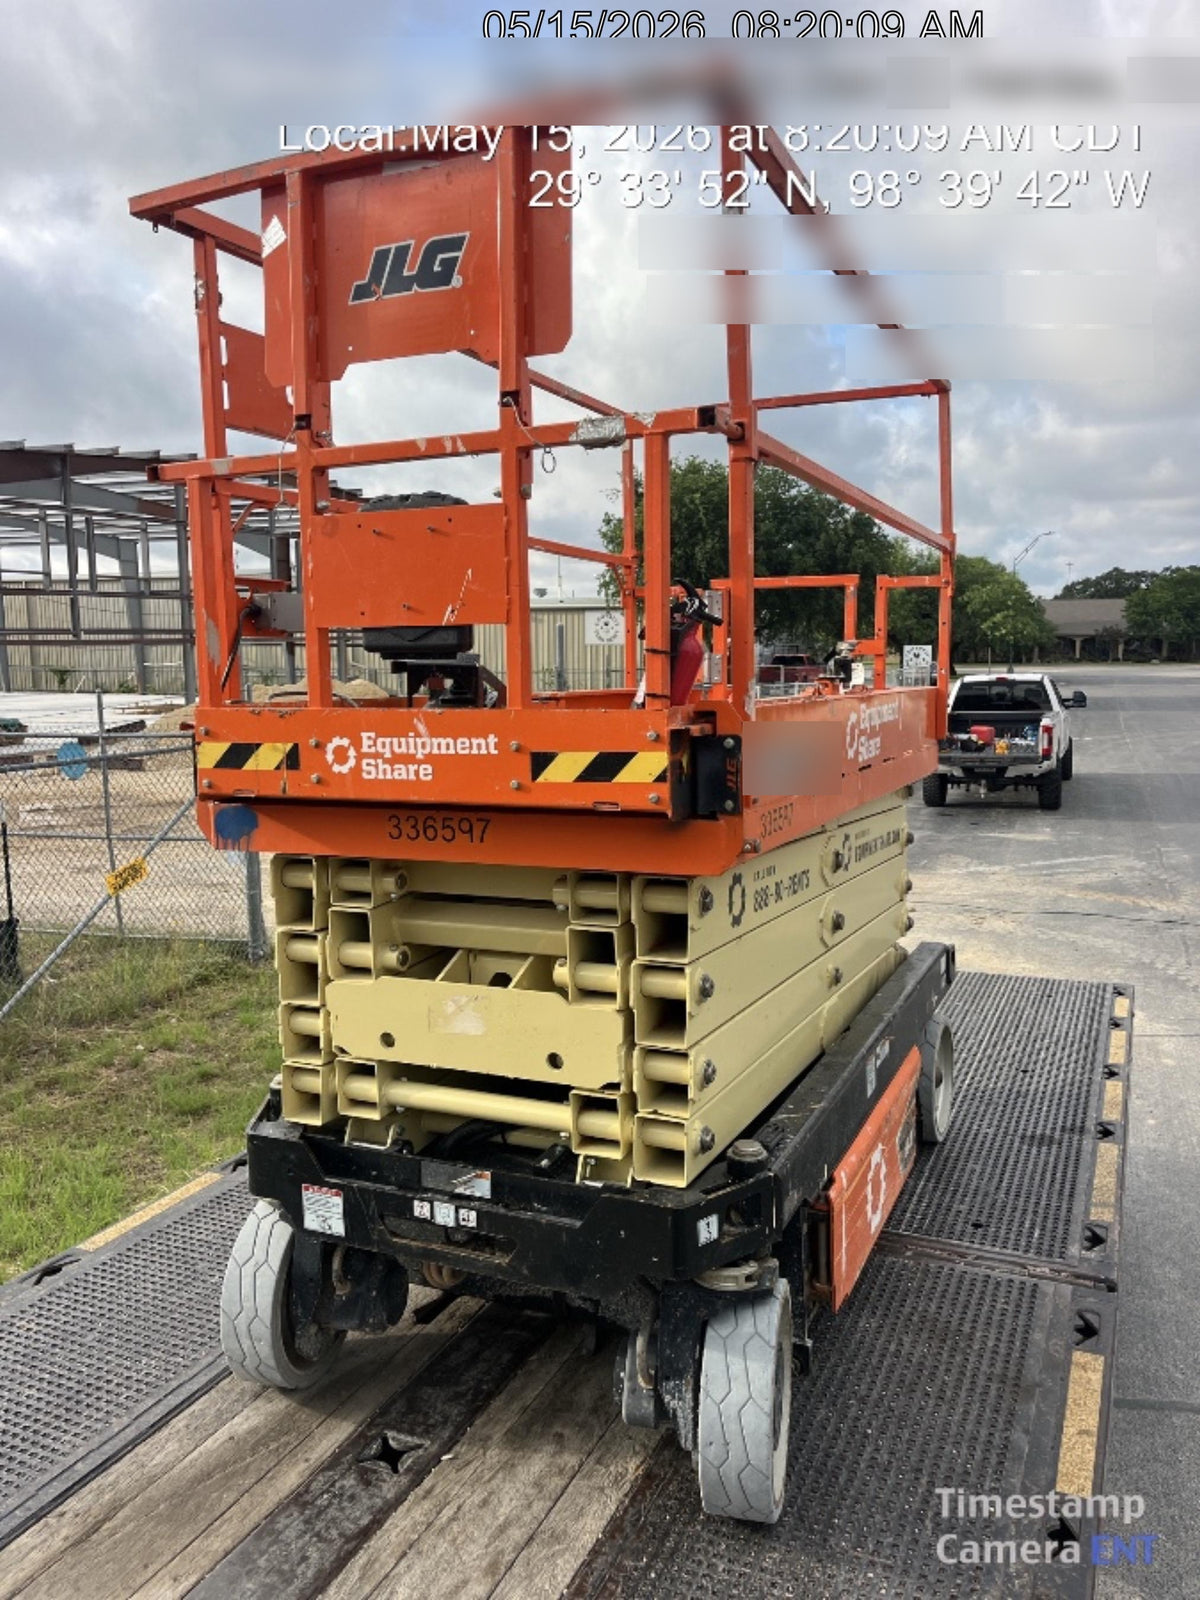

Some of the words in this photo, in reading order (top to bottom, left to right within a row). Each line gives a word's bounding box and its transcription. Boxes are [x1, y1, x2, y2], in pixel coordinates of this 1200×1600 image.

[348, 231, 470, 305] JLG
[360, 731, 498, 760] Equipment
[361, 758, 433, 781] Share
[387, 814, 491, 844] 336597
